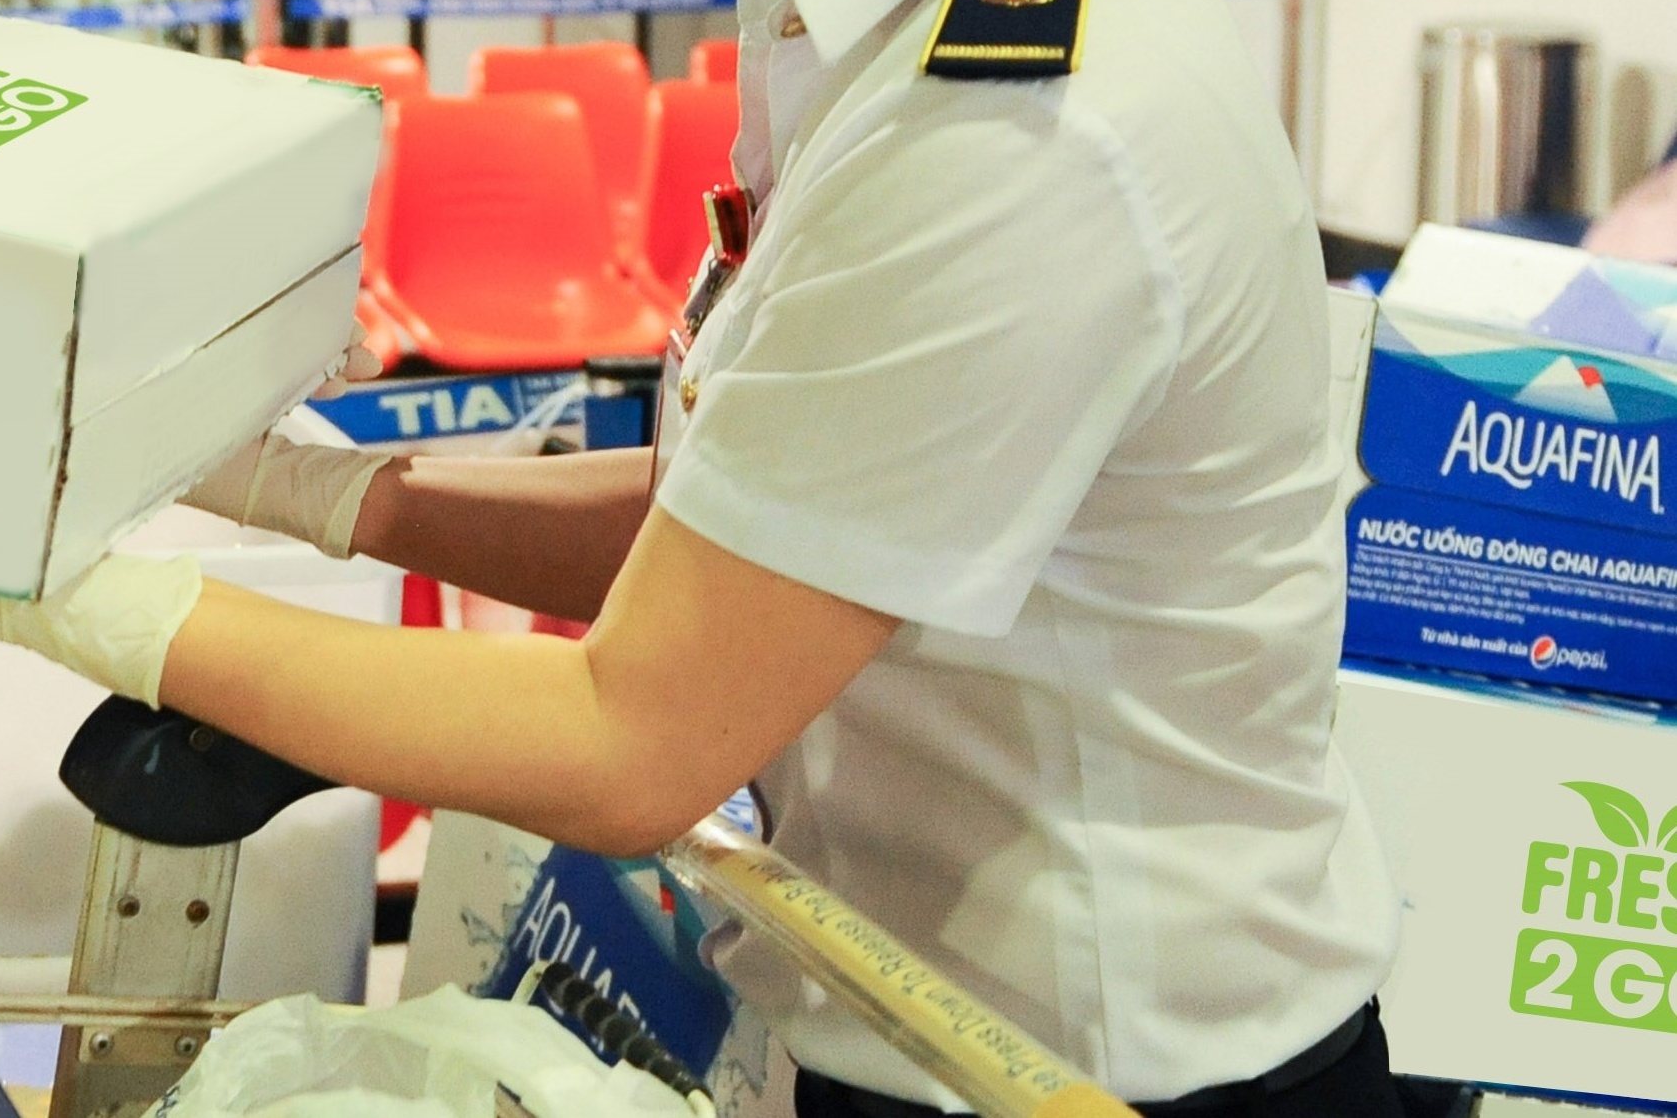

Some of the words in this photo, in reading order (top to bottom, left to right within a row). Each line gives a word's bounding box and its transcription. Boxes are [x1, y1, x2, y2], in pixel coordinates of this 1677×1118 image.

[379, 384, 515, 436] TIA
[1440, 400, 1661, 514] AQUAFINA
[1358, 517, 1421, 549] NƯỚC
[1423, 525, 1485, 559] UỐNG
[1486, 538, 1548, 569] ĐÓNG
[1551, 550, 1599, 577] CHAI
[1556, 647, 1607, 671] pepsi
[1593, 949, 1677, 1020] G
